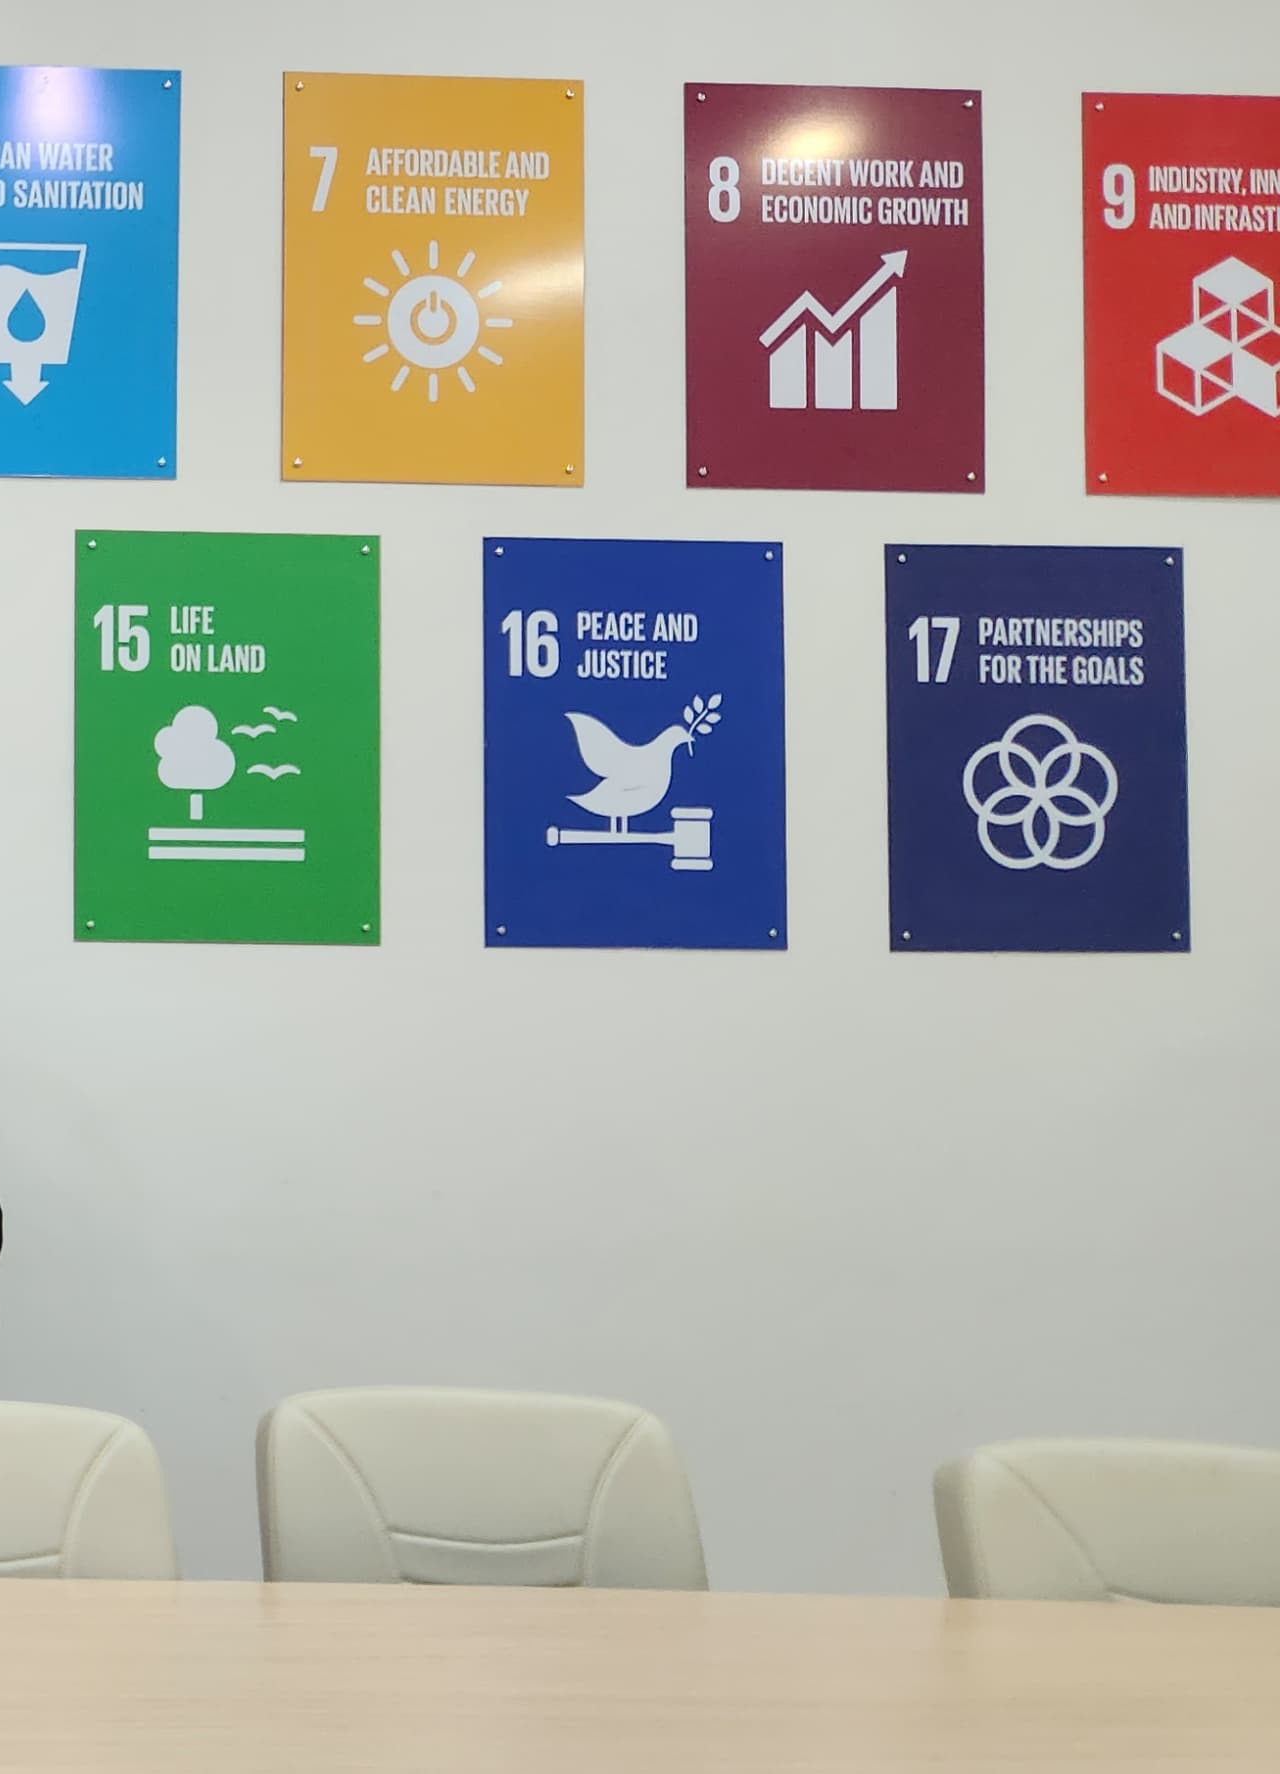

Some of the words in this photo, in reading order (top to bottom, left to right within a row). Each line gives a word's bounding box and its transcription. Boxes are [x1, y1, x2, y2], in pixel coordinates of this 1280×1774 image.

[39, 143, 114, 172] WATER
[366, 148, 500, 178] AFFORDABLE
[504, 151, 549, 179] AND
[310, 146, 338, 211] 7
[761, 158, 844, 186] DECENT
[849, 160, 914, 188] WORK
[919, 161, 963, 188] AND
[1148, 165, 1247, 197] INDUSTRY,
[13, 179, 145, 210] SANITATION
[366, 185, 435, 214] CLEAN
[445, 187, 528, 216] ENERGY
[709, 157, 740, 222] 8
[1103, 164, 1135, 229] 9
[762, 195, 872, 224] ECONOMIC
[878, 197, 968, 225] GROWTH
[1150, 203, 1191, 230] AND
[171, 606, 214, 634] LIFE
[577, 612, 645, 641] PEACE
[653, 613, 697, 641] AND
[979, 618, 1143, 647] PARTNERSHIPS
[94, 605, 149, 671] 15
[502, 611, 559, 677] 16
[909, 617, 959, 682] 17
[171, 643, 200, 672] ON
[208, 644, 265, 673] LAND
[578, 650, 667, 678] JUSTICE
[980, 655, 1021, 683] FOR
[1026, 655, 1067, 684] THE
[1072, 656, 1144, 685] GOALS
